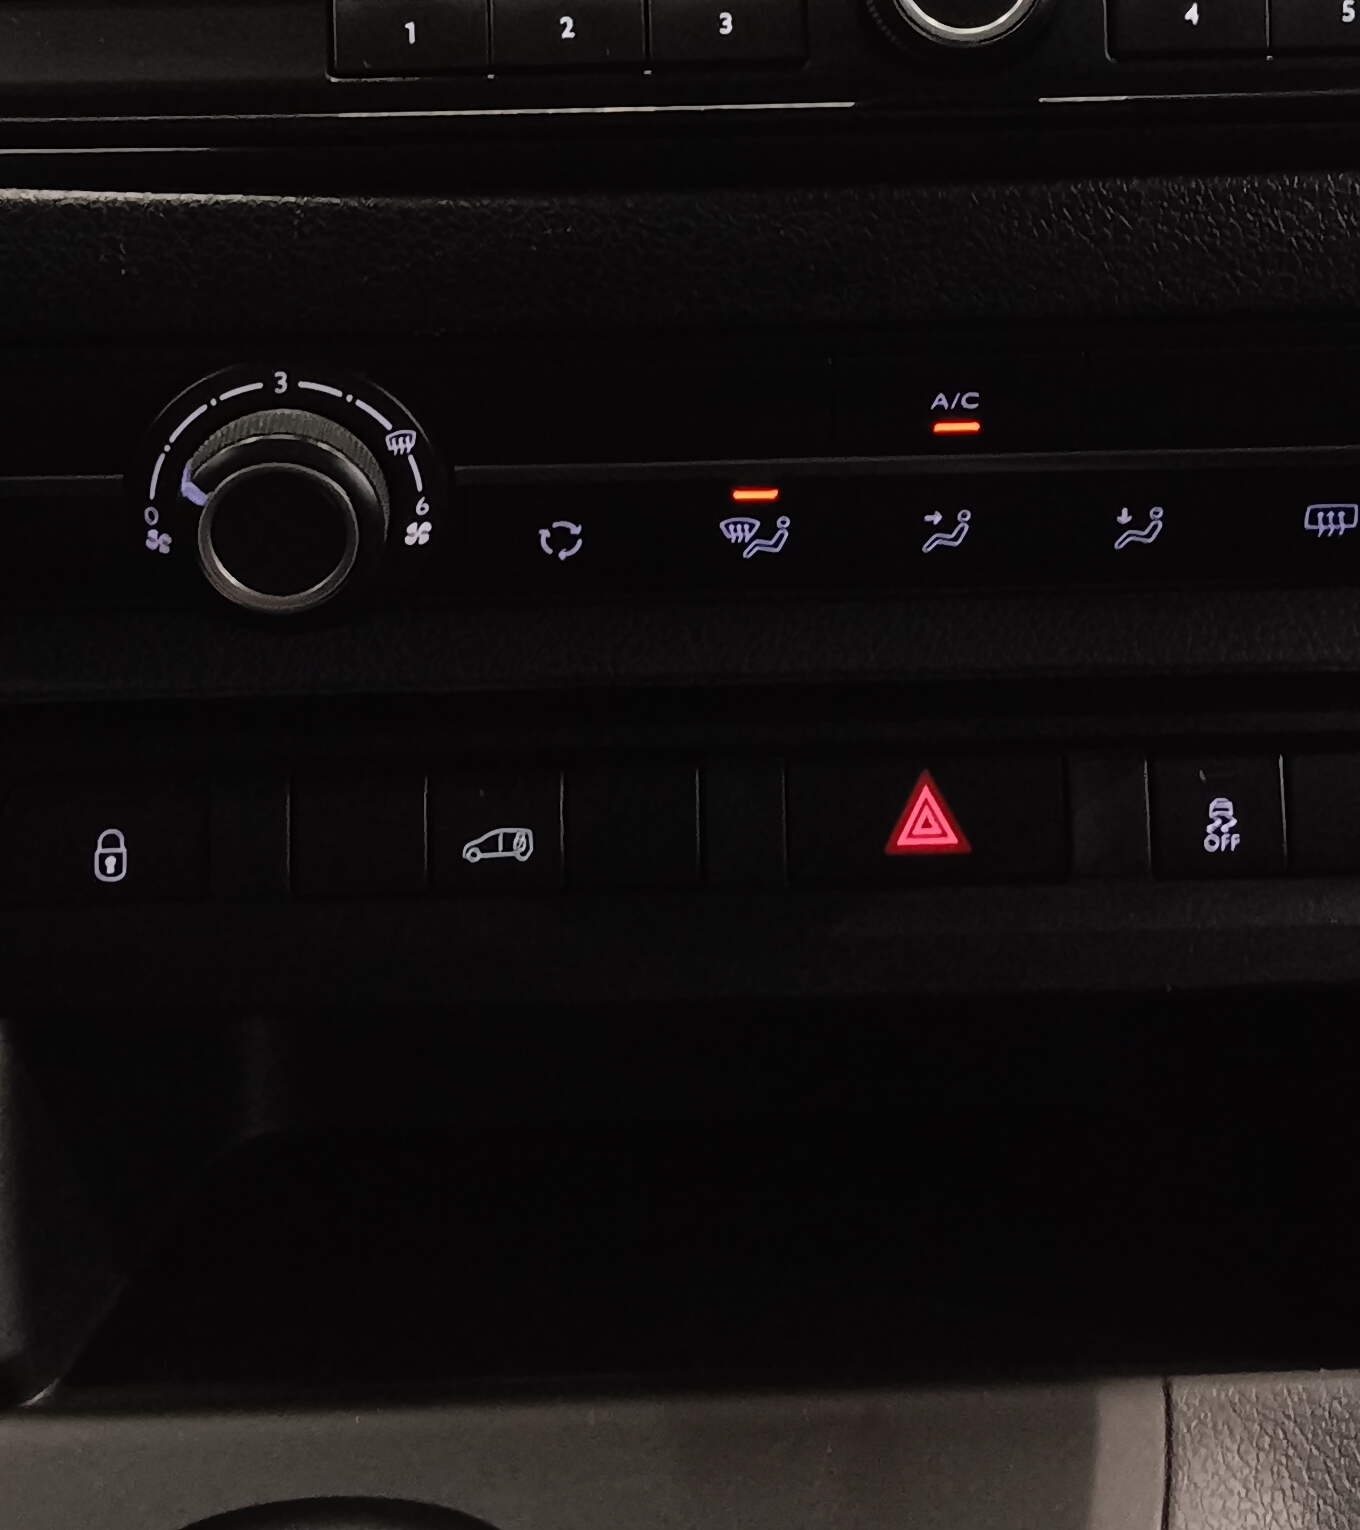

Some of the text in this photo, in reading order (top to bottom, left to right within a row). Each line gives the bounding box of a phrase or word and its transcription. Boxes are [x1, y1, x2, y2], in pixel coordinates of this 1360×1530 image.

[719, 11, 733, 35] 3
[1184, 2, 1199, 25] 4
[1341, 0, 1356, 23] 5
[404, 21, 416, 45] 1
[559, 15, 576, 39] 2
[274, 371, 288, 394] 3
[930, 391, 980, 410] A/C
[144, 506, 159, 526] 0
[415, 496, 430, 516] 6
[1202, 832, 1242, 854] OFF
